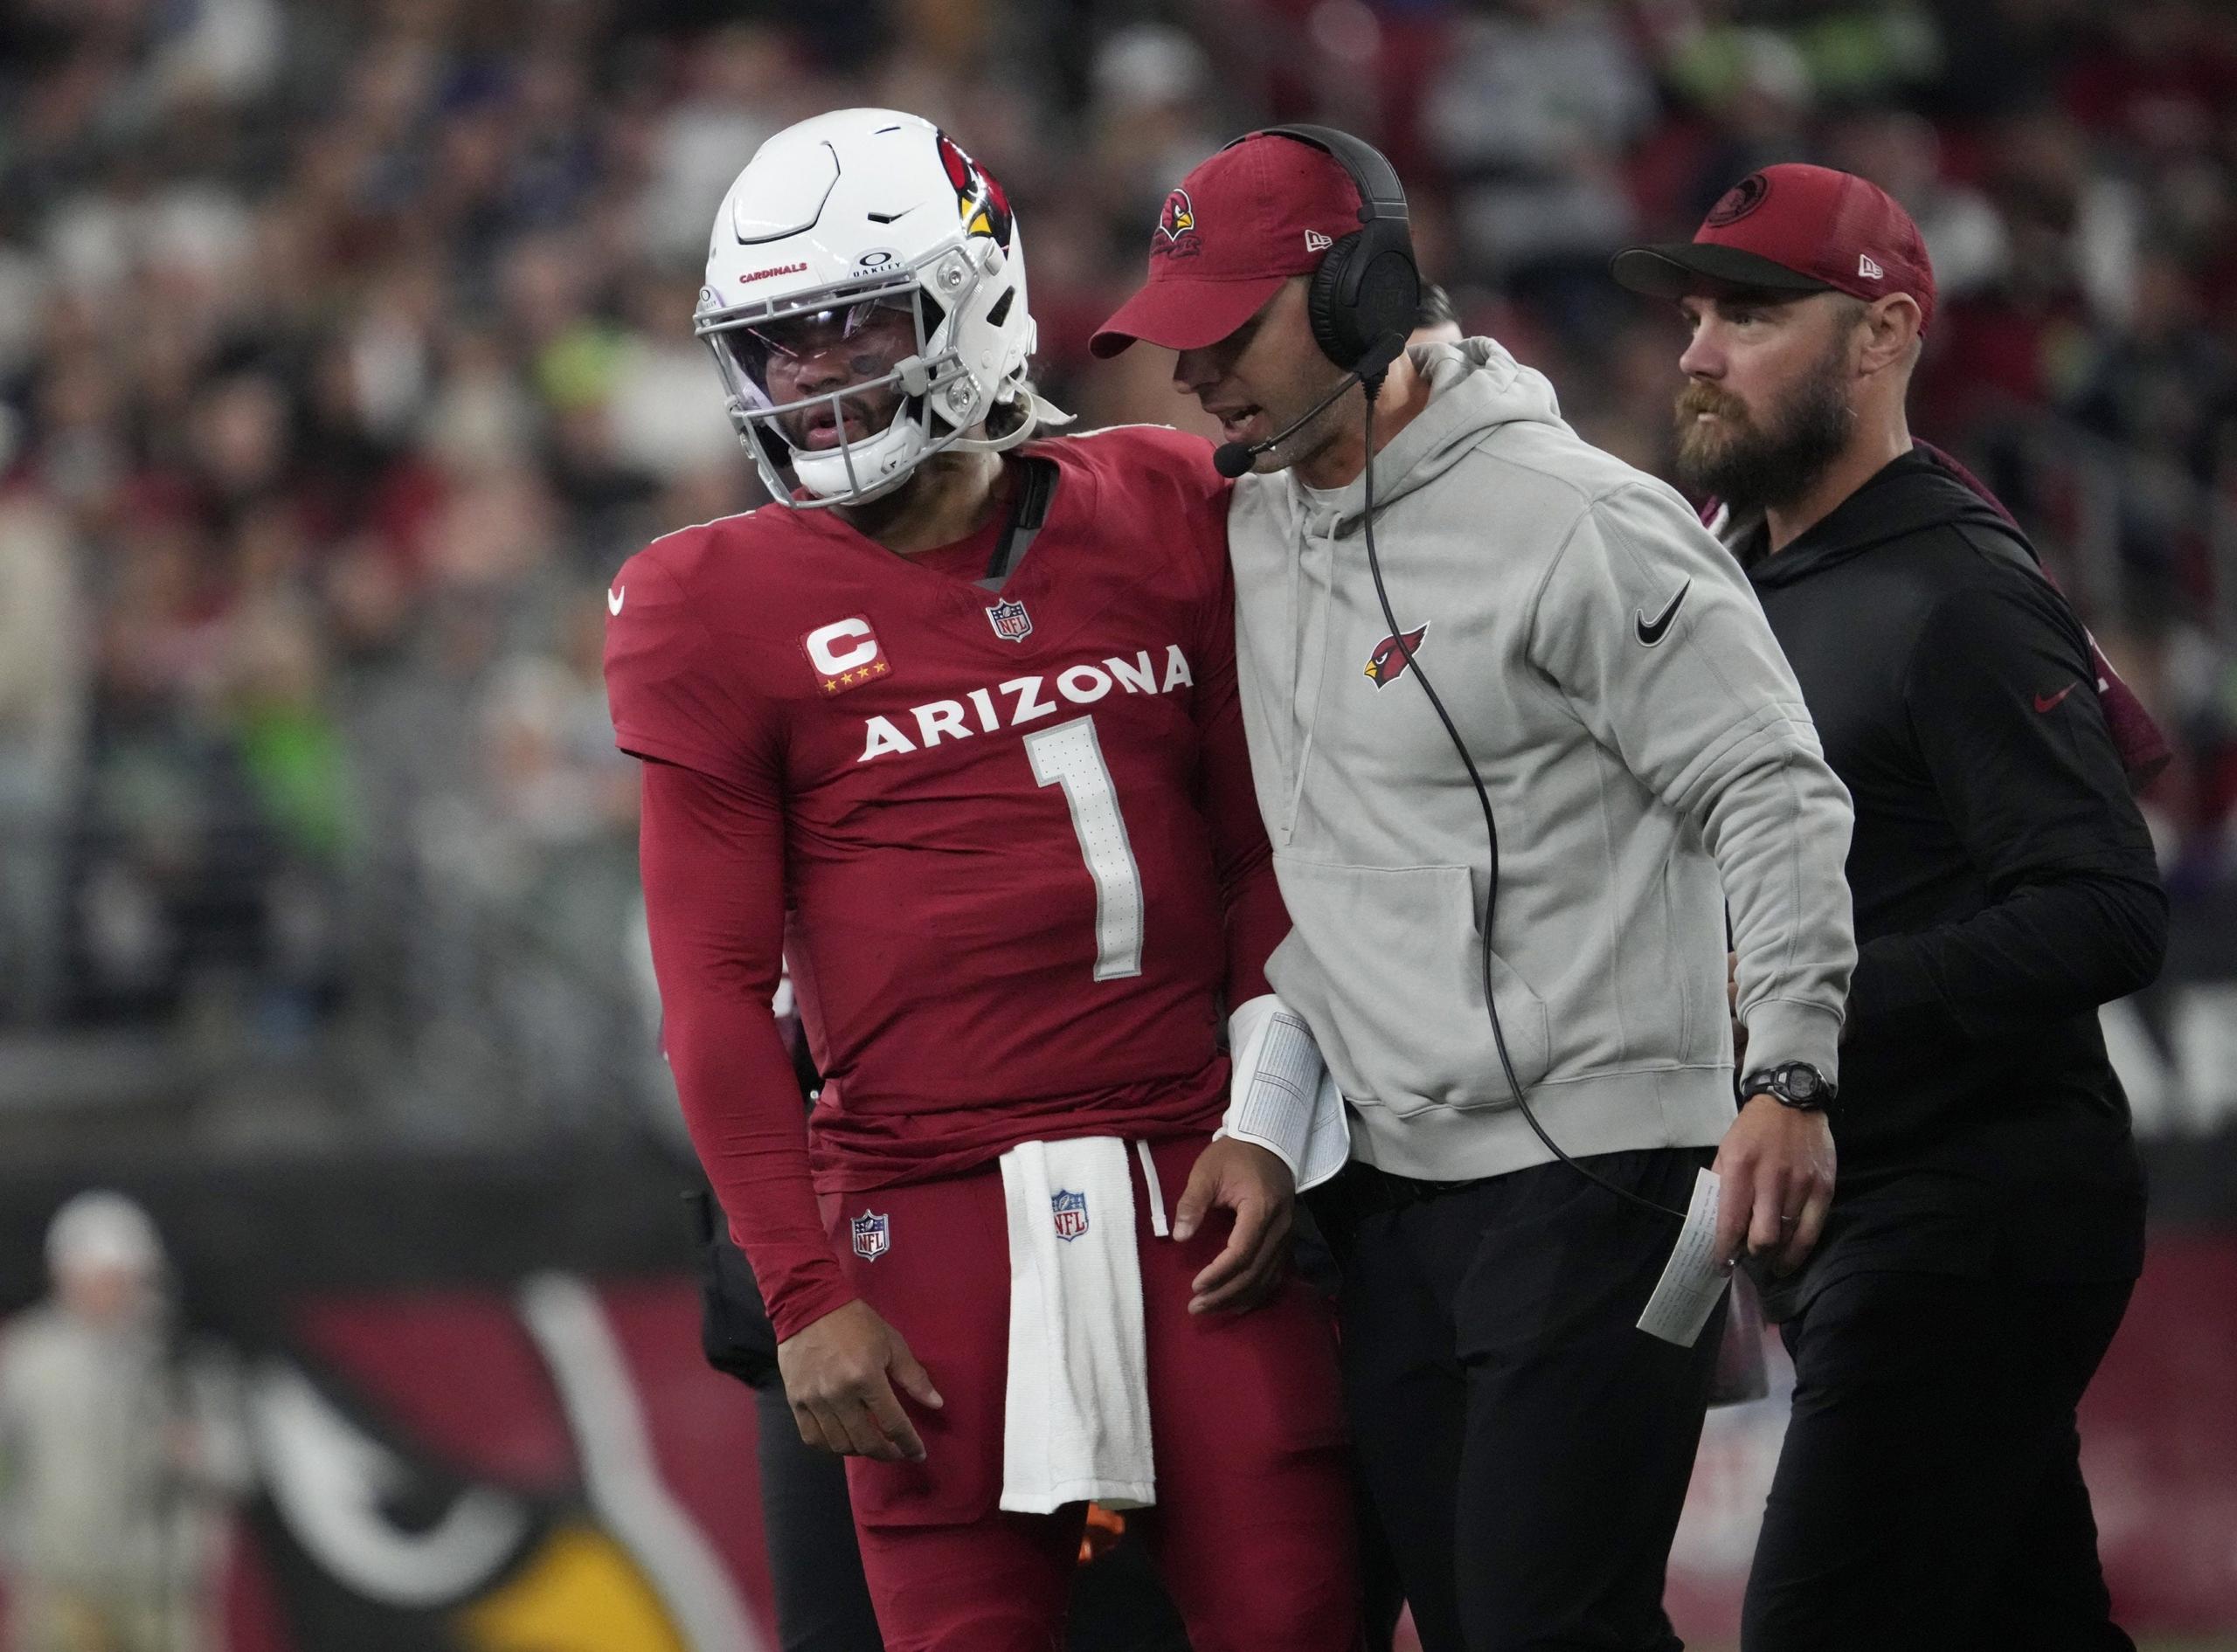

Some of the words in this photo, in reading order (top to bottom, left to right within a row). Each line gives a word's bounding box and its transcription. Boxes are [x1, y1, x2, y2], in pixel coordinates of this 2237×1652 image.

[739, 262, 807, 284] CARDINALS
[853, 262, 901, 278] OAKLEY
[998, 616, 1027, 634] NFL
[806, 617, 878, 676] C
[857, 644, 1195, 763] ARIZONA
[1022, 715, 1145, 982] 1
[1054, 1211, 1085, 1236] NFL
[858, 1233, 883, 1252] NFL
